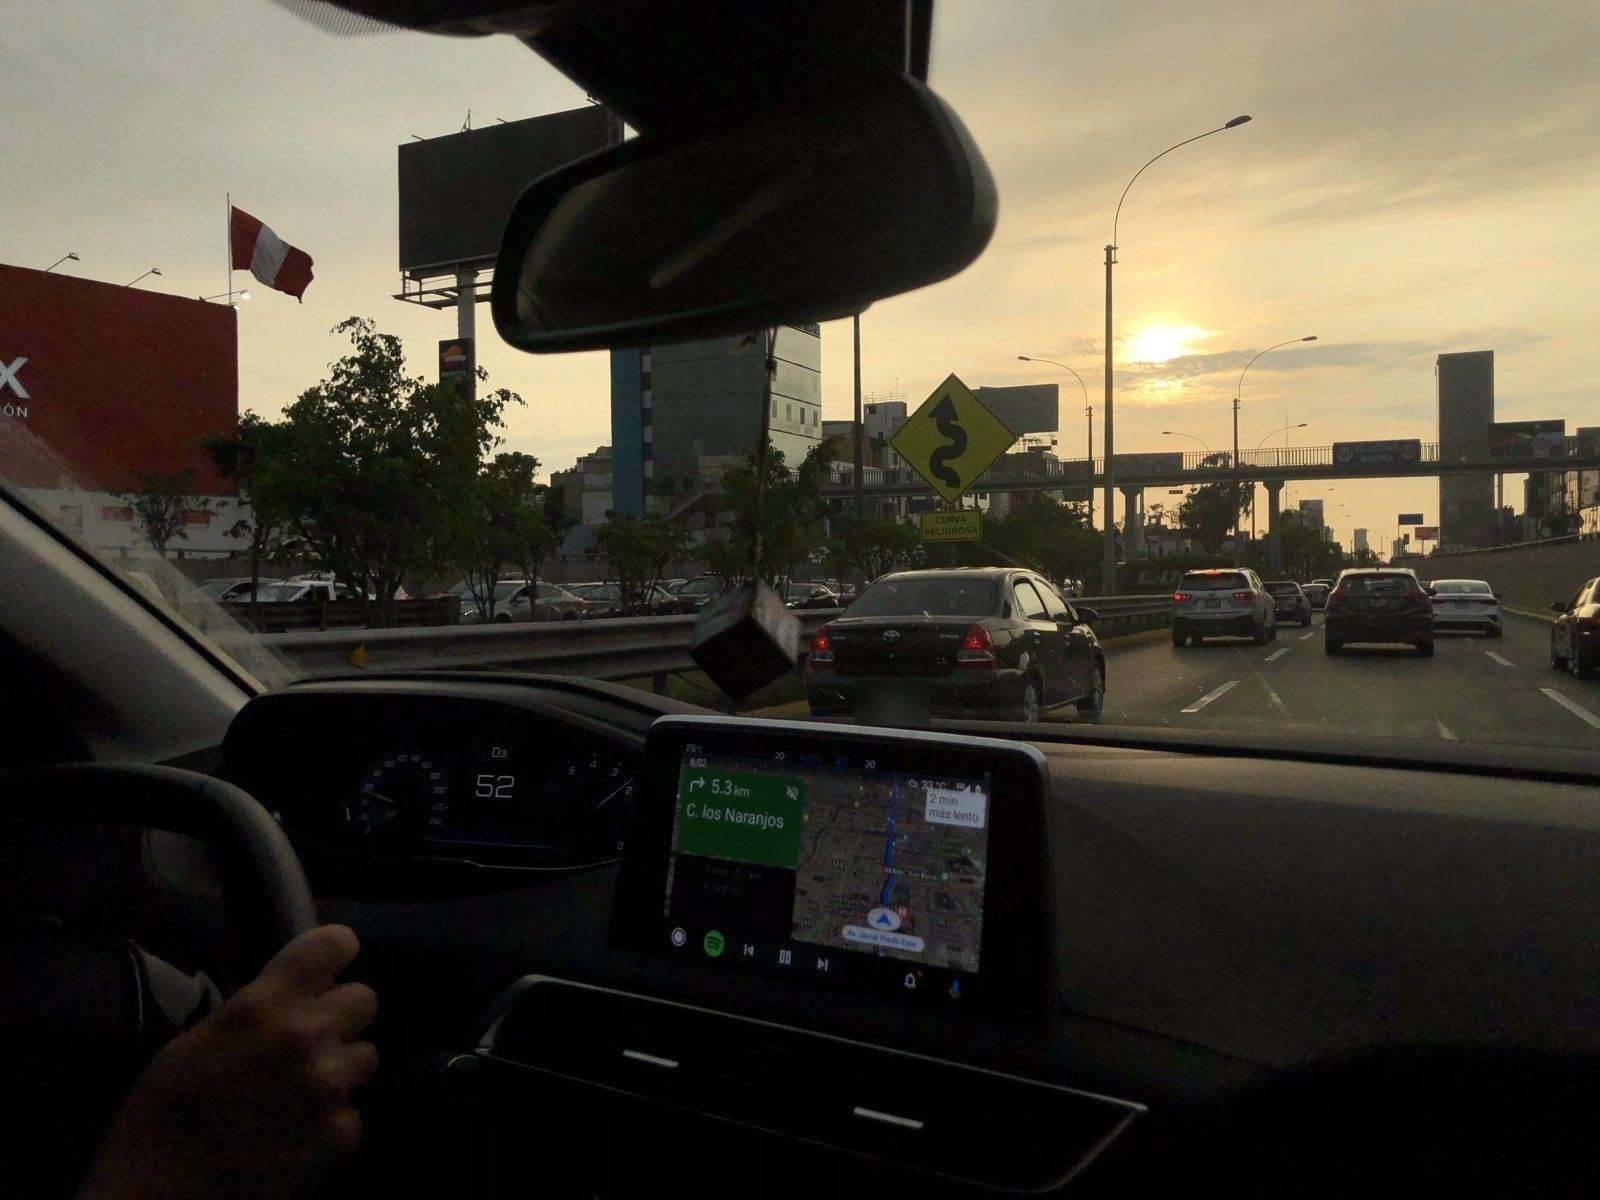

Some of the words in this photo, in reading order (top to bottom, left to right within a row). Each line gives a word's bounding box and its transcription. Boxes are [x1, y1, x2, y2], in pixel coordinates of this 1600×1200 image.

[935, 515, 967, 525] CURVA
[923, 526, 978, 536] PELIGROSA
[475, 774, 514, 798] 52
[711, 778, 732, 796] 5.3
[734, 784, 751, 798] km
[930, 793, 937, 804] 2
[939, 795, 959, 806] min
[686, 802, 699, 818] C.
[702, 804, 722, 820] los
[724, 807, 785, 830] Naranjos
